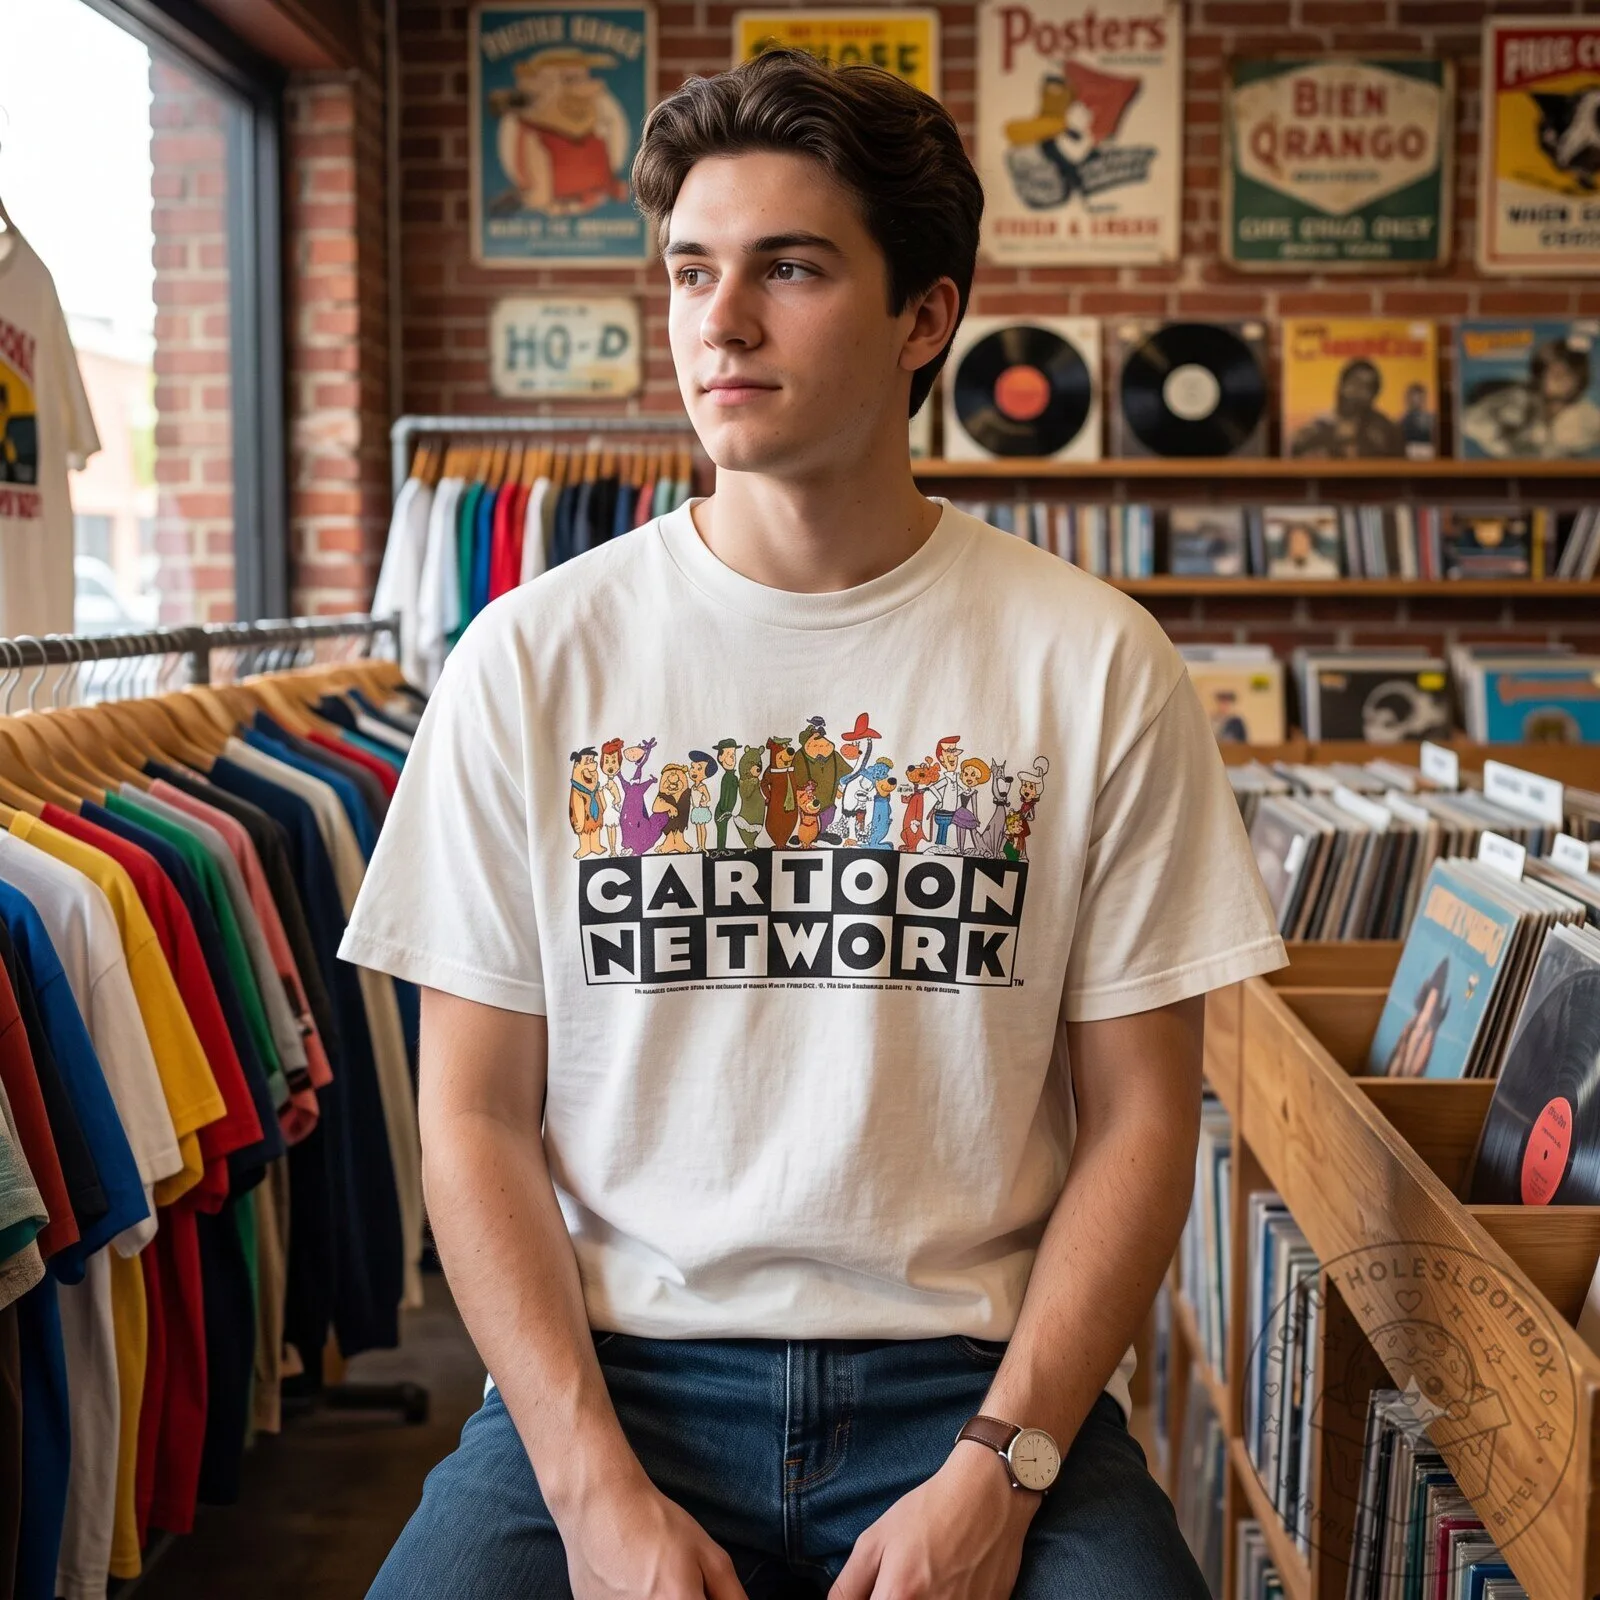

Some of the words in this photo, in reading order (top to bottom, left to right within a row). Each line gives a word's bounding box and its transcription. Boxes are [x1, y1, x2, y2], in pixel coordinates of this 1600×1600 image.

[998, 5, 1166, 75] Posters
[1293, 77, 1387, 118] BIEN
[585, 858, 1017, 921] CARTOON
[589, 921, 1012, 977] NETWORK
